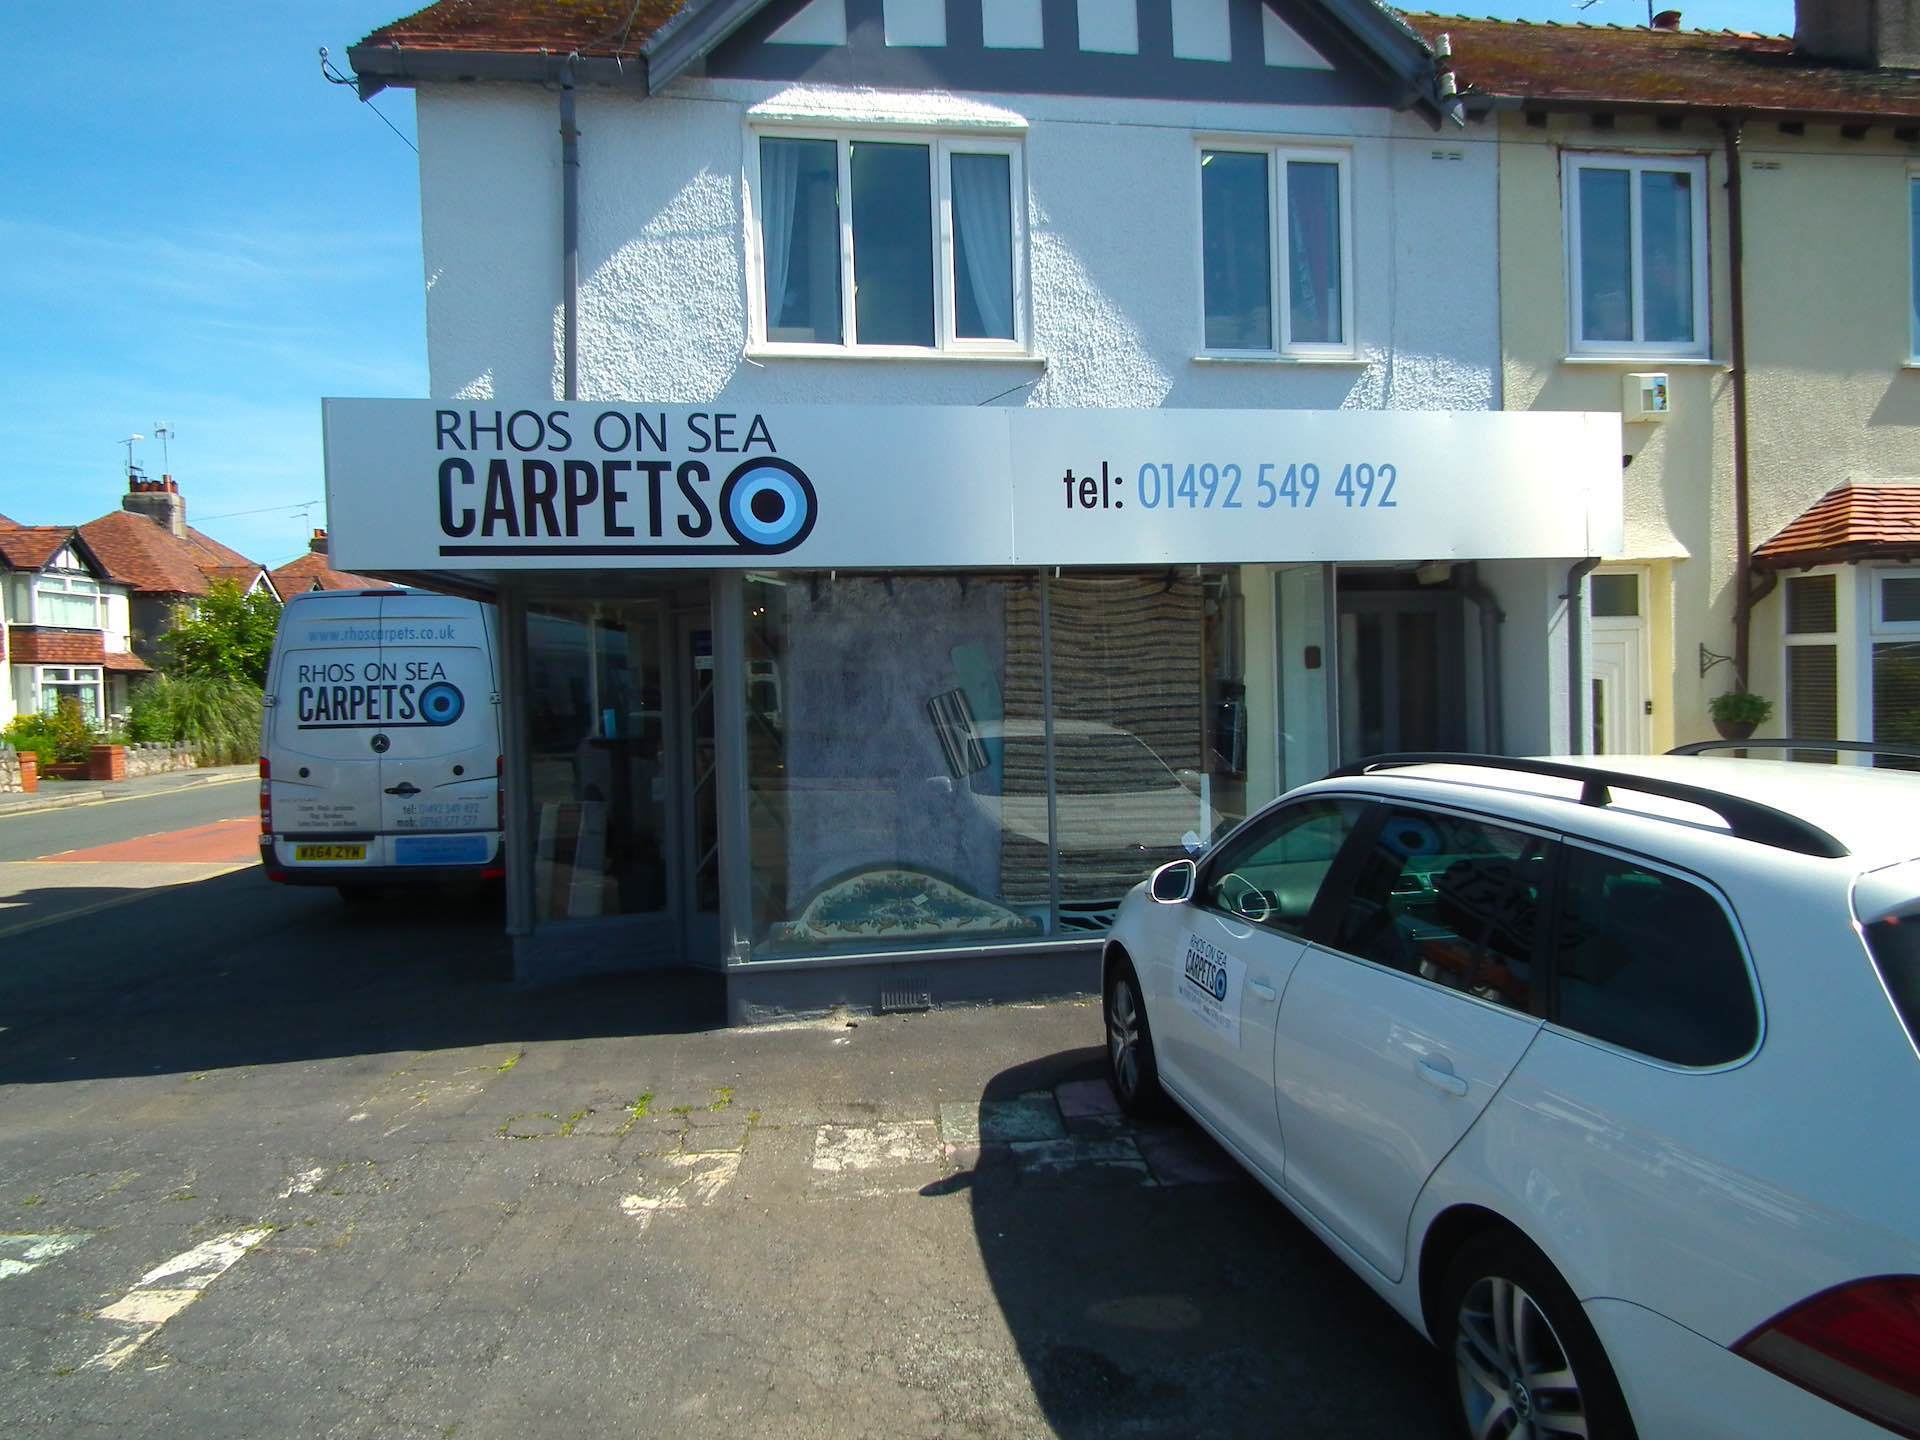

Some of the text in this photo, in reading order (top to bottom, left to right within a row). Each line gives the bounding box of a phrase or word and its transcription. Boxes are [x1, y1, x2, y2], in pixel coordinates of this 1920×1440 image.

[436, 410, 777, 453] RHOS ON SEA
[438, 457, 713, 538] CARPETS
[1063, 461, 1397, 509] tel: 01492 549 492
[308, 625, 456, 642] www.rhoscarpets.co.uk
[299, 662, 447, 683] RHOS ON SEA
[298, 684, 416, 722] CARPETS
[1184, 948, 1217, 990] CARPETS
